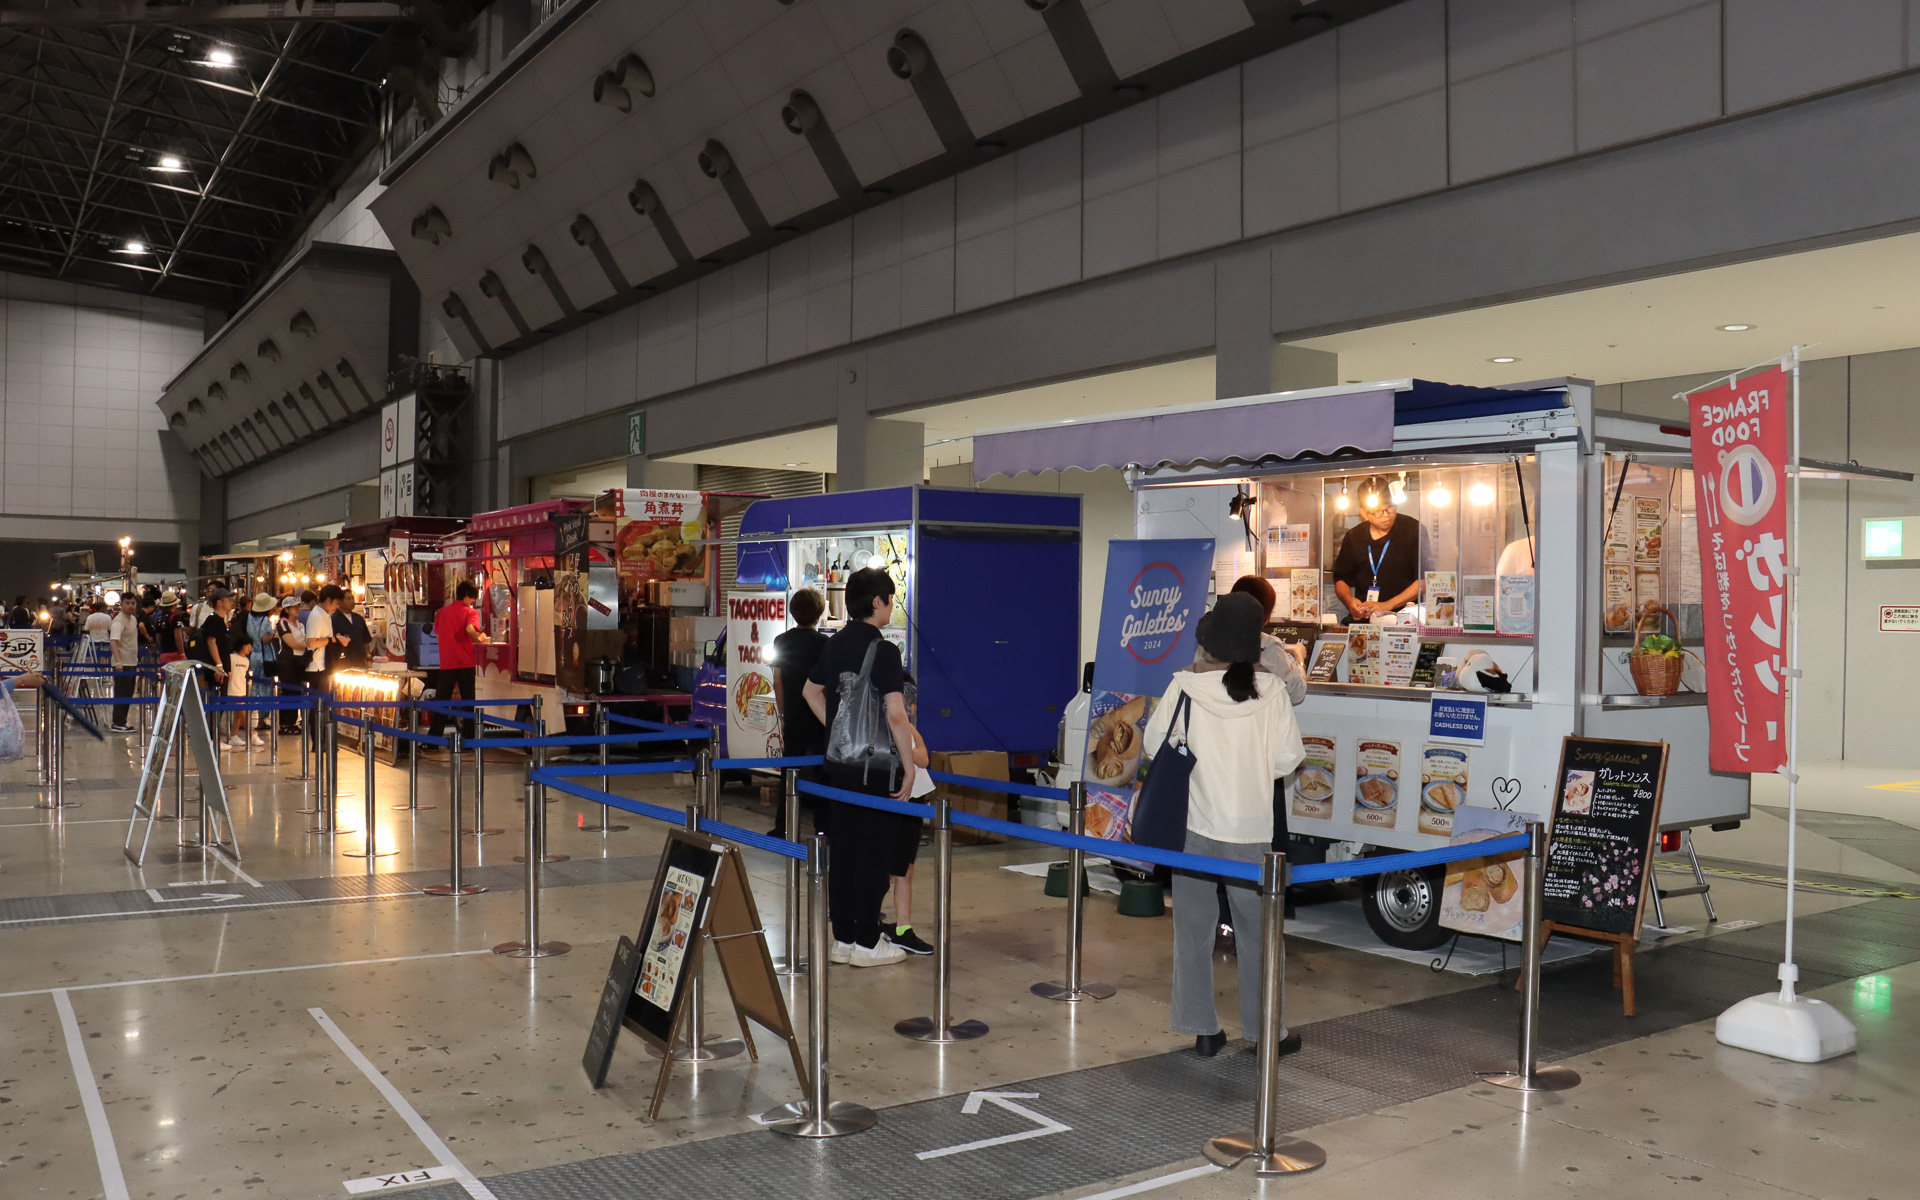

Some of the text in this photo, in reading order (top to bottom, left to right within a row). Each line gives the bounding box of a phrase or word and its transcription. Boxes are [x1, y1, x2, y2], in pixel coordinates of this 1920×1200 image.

[640, 490, 688, 499] 肉屋のまかない
[644, 501, 684, 515] 角煮丼
[1130, 584, 1182, 614] Sunny
[729, 598, 786, 621] TACORICE
[750, 621, 760, 643] &
[1120, 610, 1186, 648] Galettes
[1144, 640, 1161, 649] 2024
[738, 645, 772, 664] TACO
[1598, 767, 1651, 784] ガレットソシス
[1633, 788, 1653, 800] ¥800
[1304, 804, 1320, 812] 700円
[1366, 813, 1383, 821] 600円
[1431, 817, 1450, 826] 500円
[1507, 814, 1530, 828] ¥80
[676, 872, 694, 887] MENU
[376, 1170, 432, 1187] FIX
